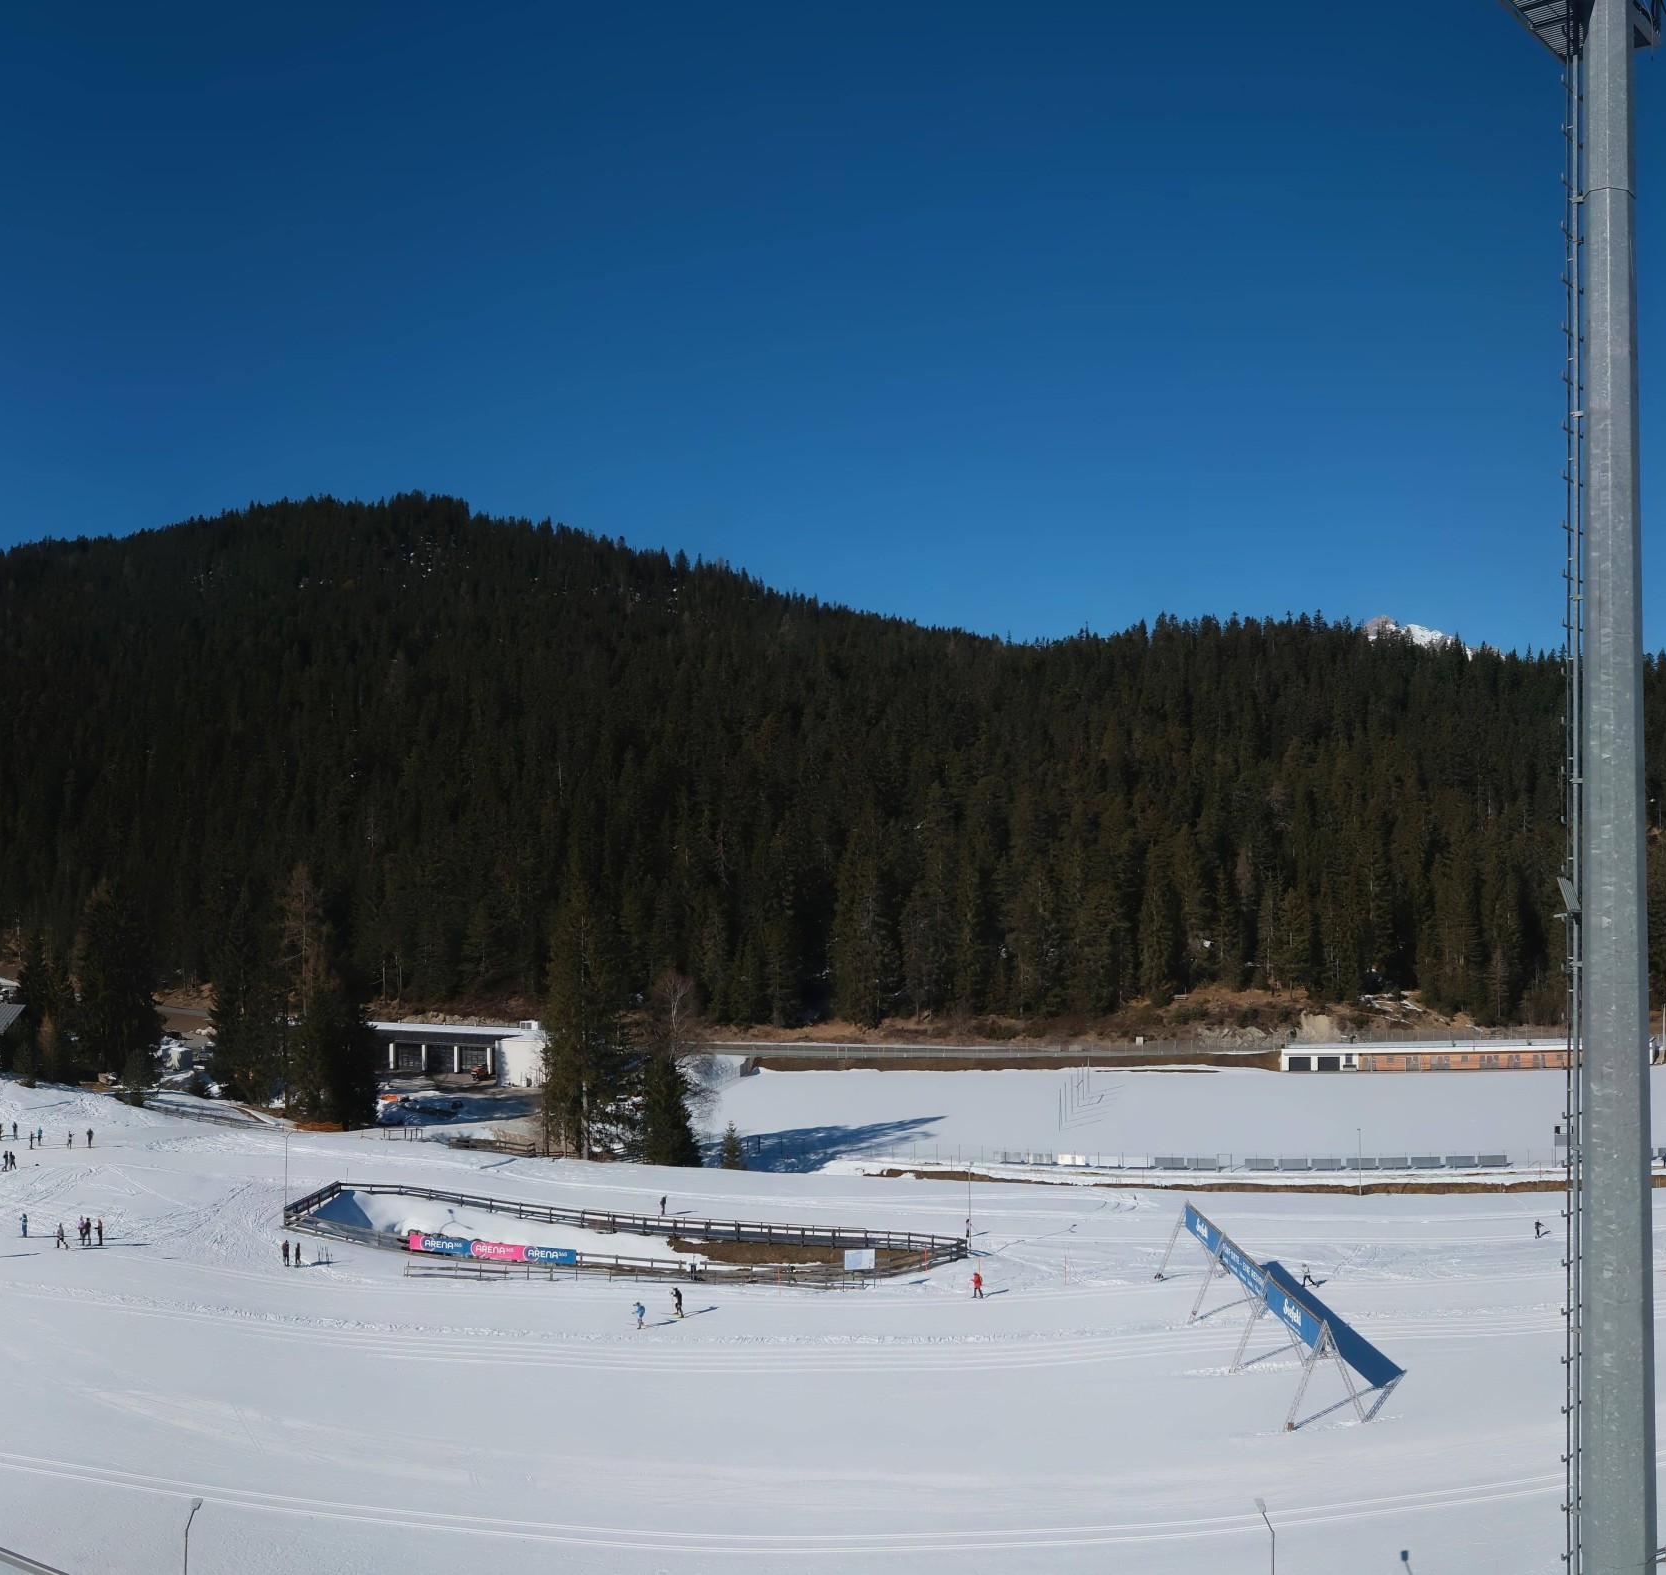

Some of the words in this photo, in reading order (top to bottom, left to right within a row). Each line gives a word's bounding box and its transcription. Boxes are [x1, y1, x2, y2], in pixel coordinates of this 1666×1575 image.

[425, 1239, 453, 1249] ARENA
[476, 1246, 505, 1254] ARENA
[528, 1250, 558, 1258] ARENA
